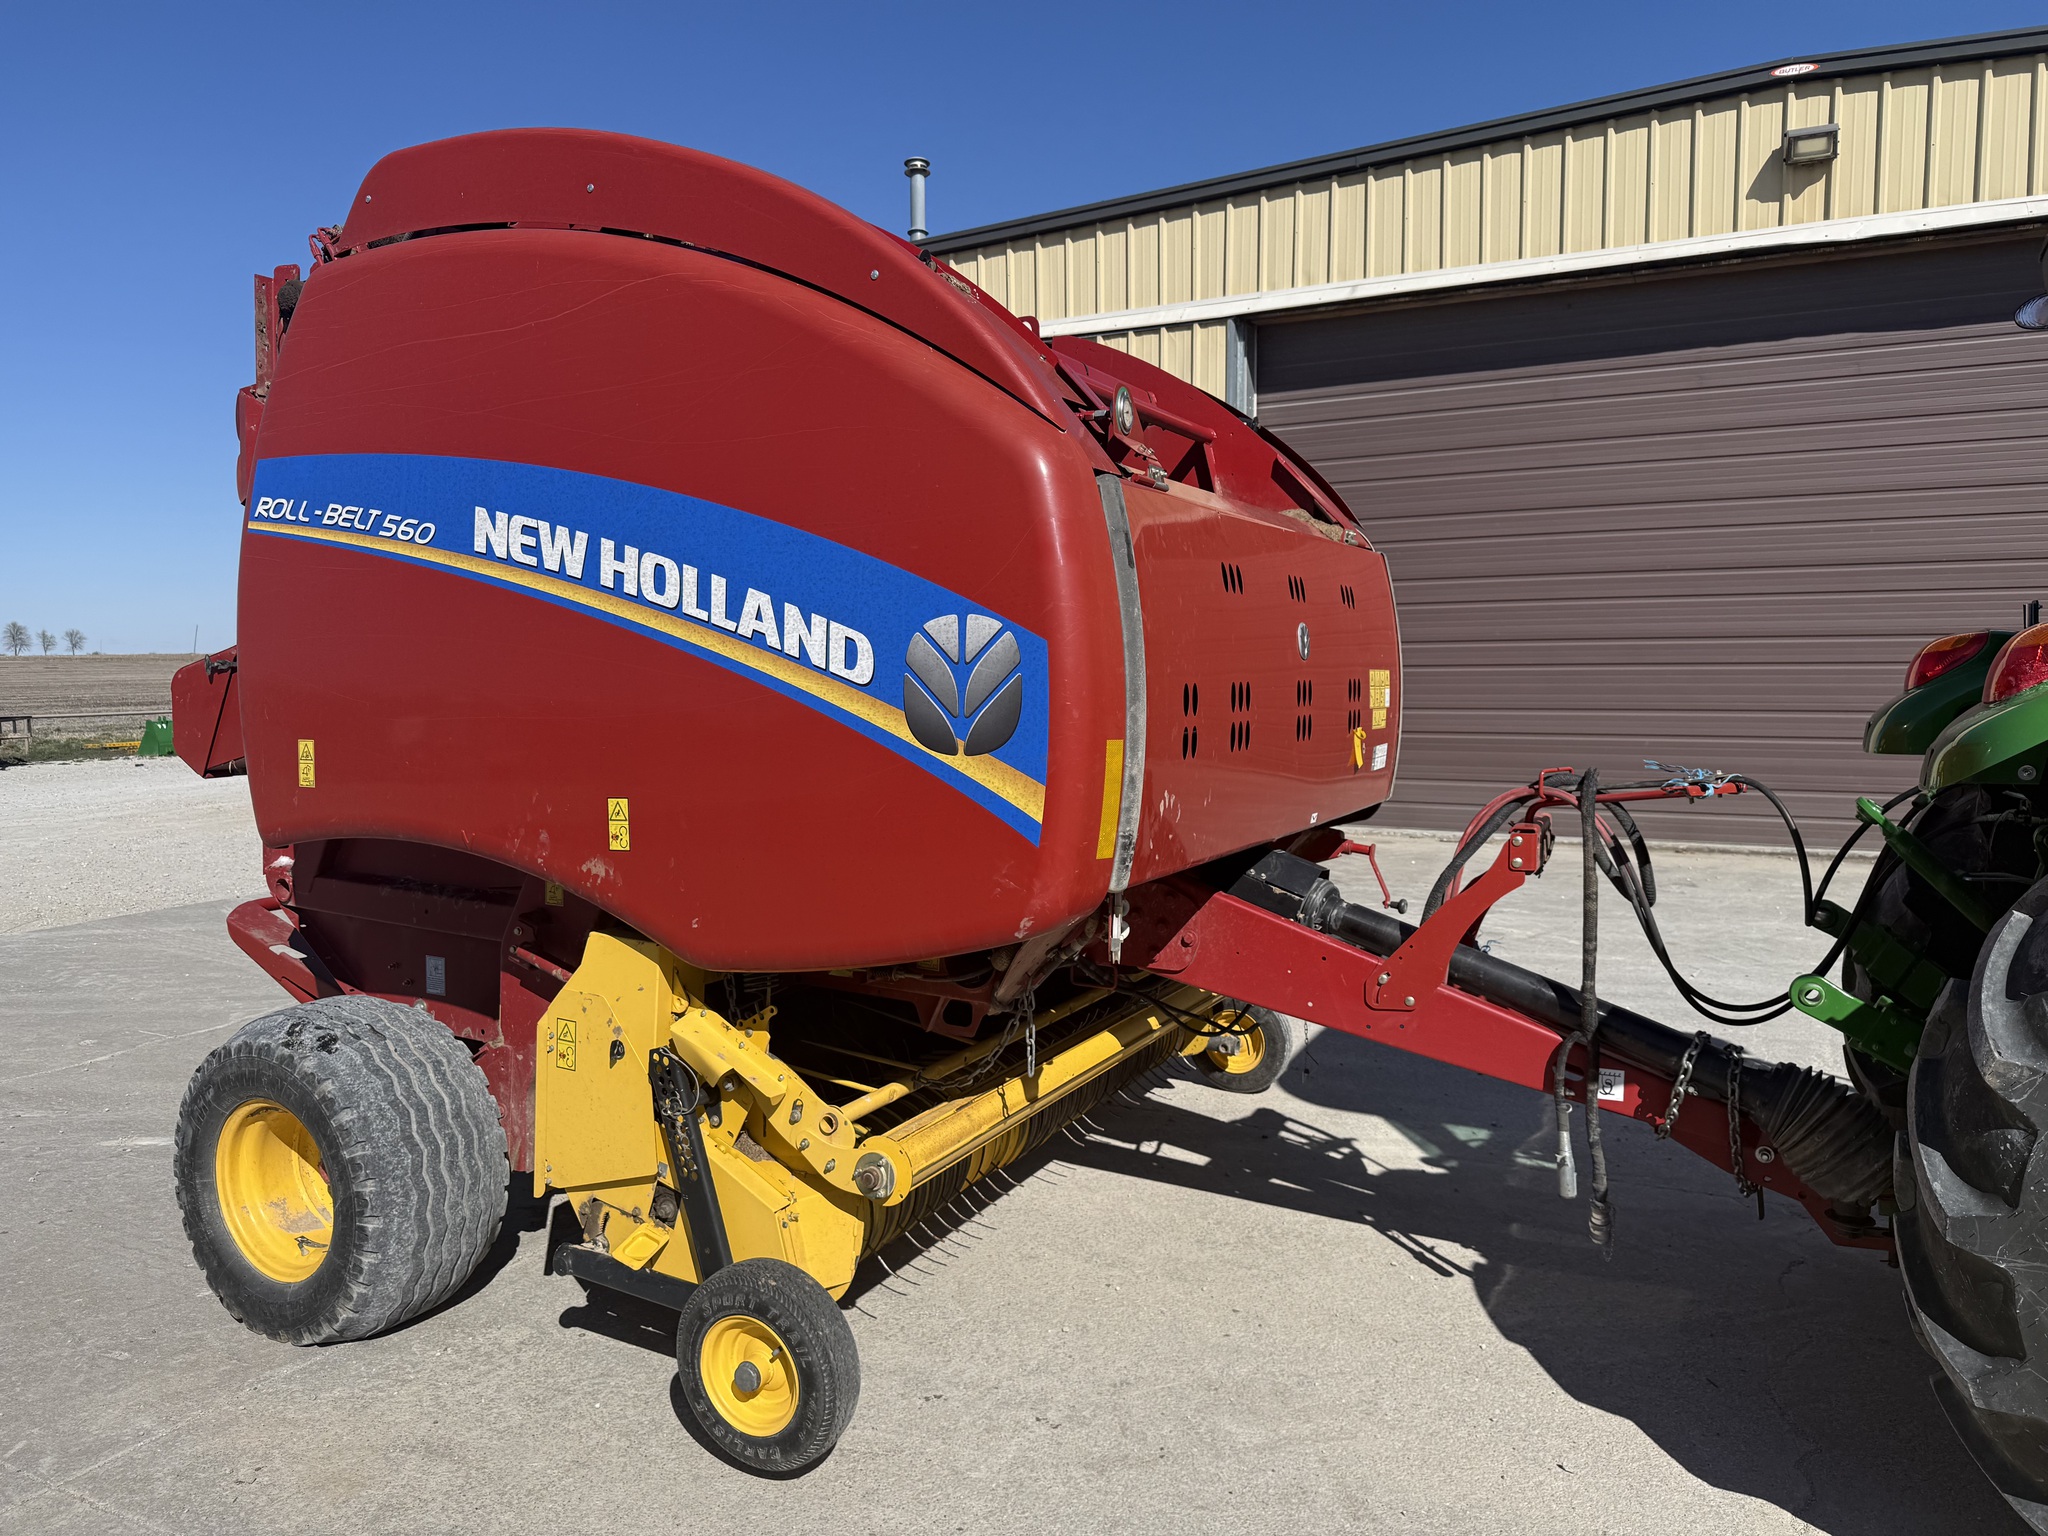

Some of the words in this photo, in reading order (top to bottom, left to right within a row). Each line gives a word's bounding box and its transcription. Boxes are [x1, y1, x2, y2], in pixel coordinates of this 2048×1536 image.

[1778, 65, 1811, 74] BUTLER
[254, 496, 383, 532] ROLL-BELT
[378, 514, 436, 545] 560
[473, 505, 589, 580] NEW
[600, 536, 875, 686] HOLLAND
[701, 1293, 760, 1317] SPORT
[766, 1305, 812, 1369] TRAIL
[694, 1399, 781, 1461] CARLISLE
